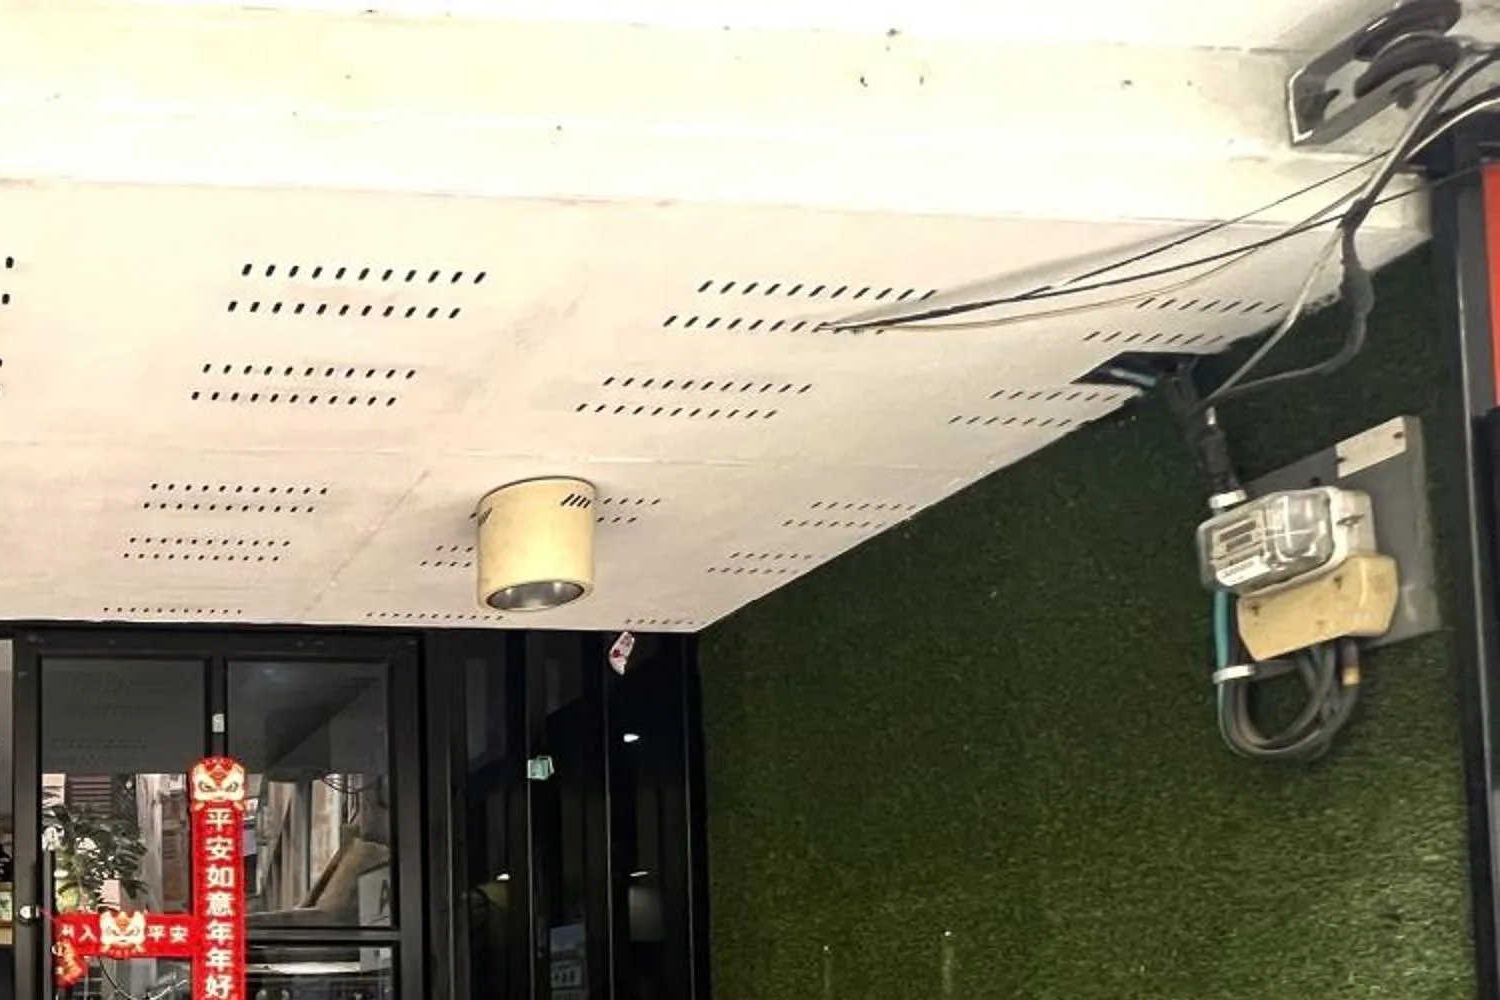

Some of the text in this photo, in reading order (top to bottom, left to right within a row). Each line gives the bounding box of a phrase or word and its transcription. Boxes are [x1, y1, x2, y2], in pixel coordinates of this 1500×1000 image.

[205, 808, 235, 1000] 平安如意年年好
